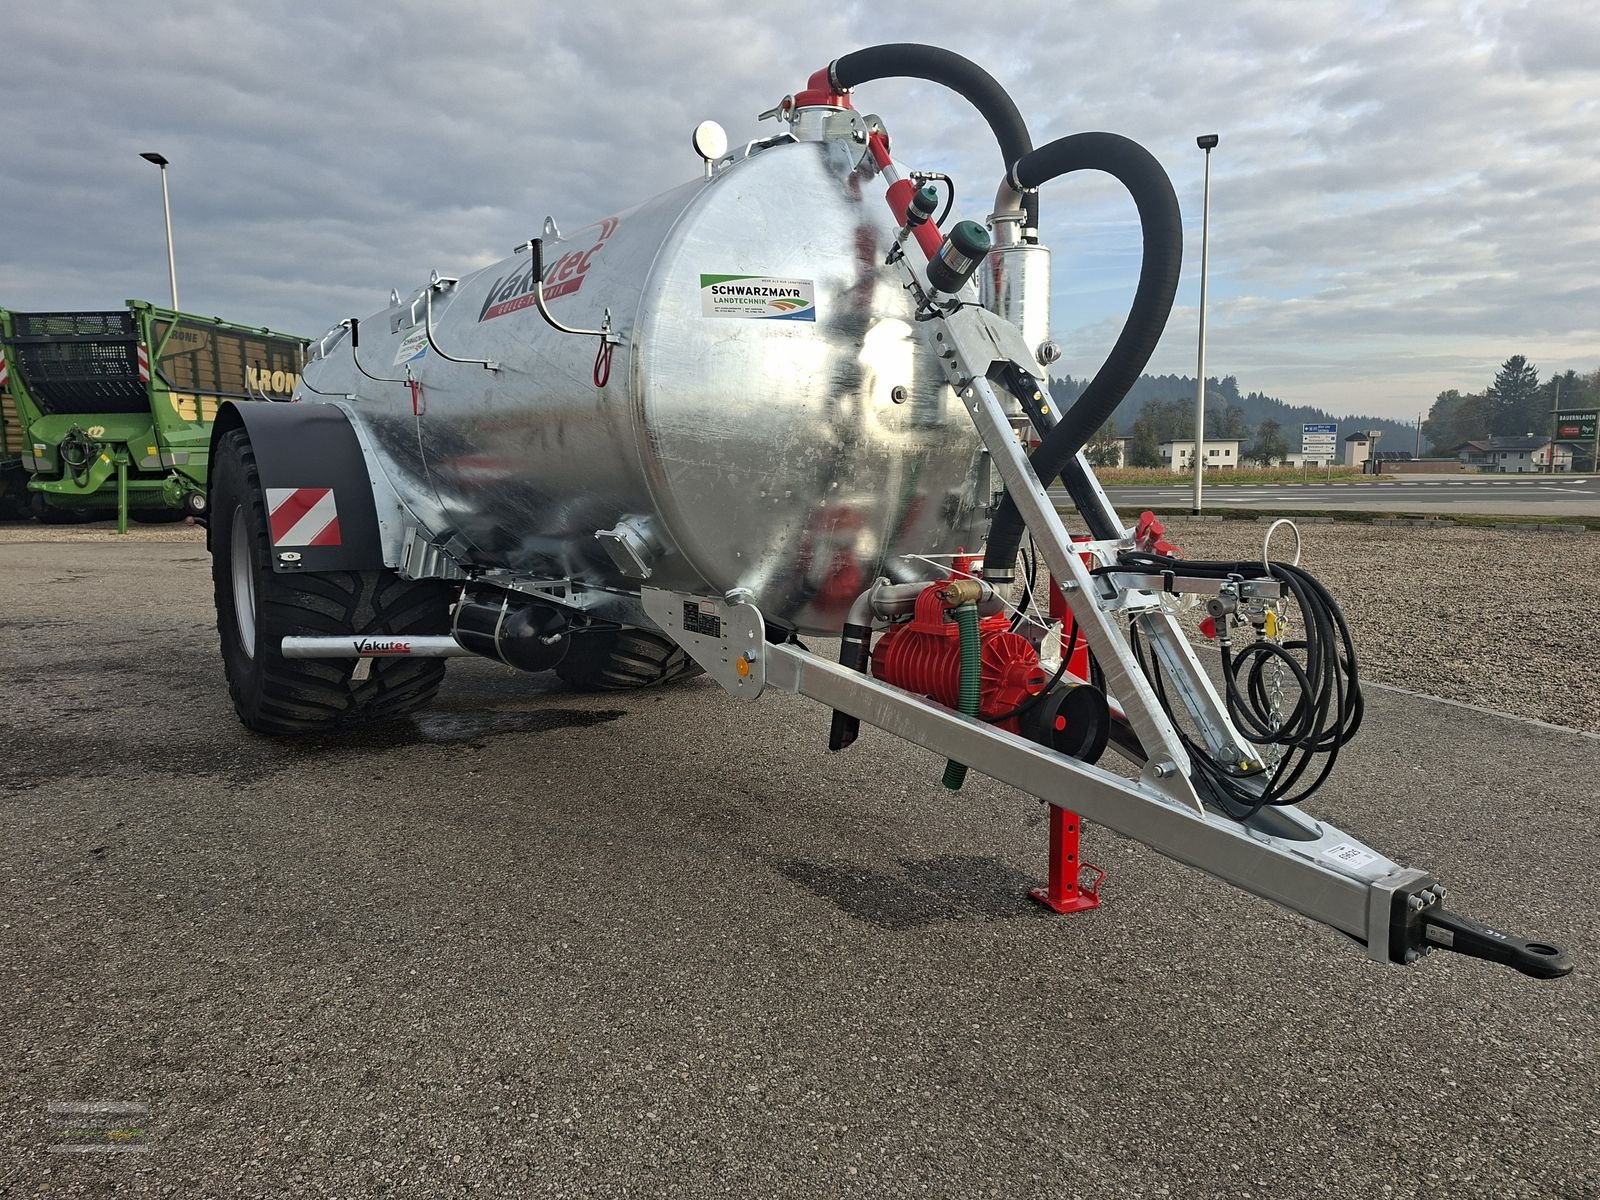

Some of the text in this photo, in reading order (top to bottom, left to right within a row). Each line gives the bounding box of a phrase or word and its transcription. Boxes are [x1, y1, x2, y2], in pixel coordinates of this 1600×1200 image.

[711, 285, 800, 298] SCHWARZMAYR
[713, 297, 767, 305] LANDTECHNIK
[169, 329, 198, 344] RONE
[353, 638, 411, 654] Vakutec
